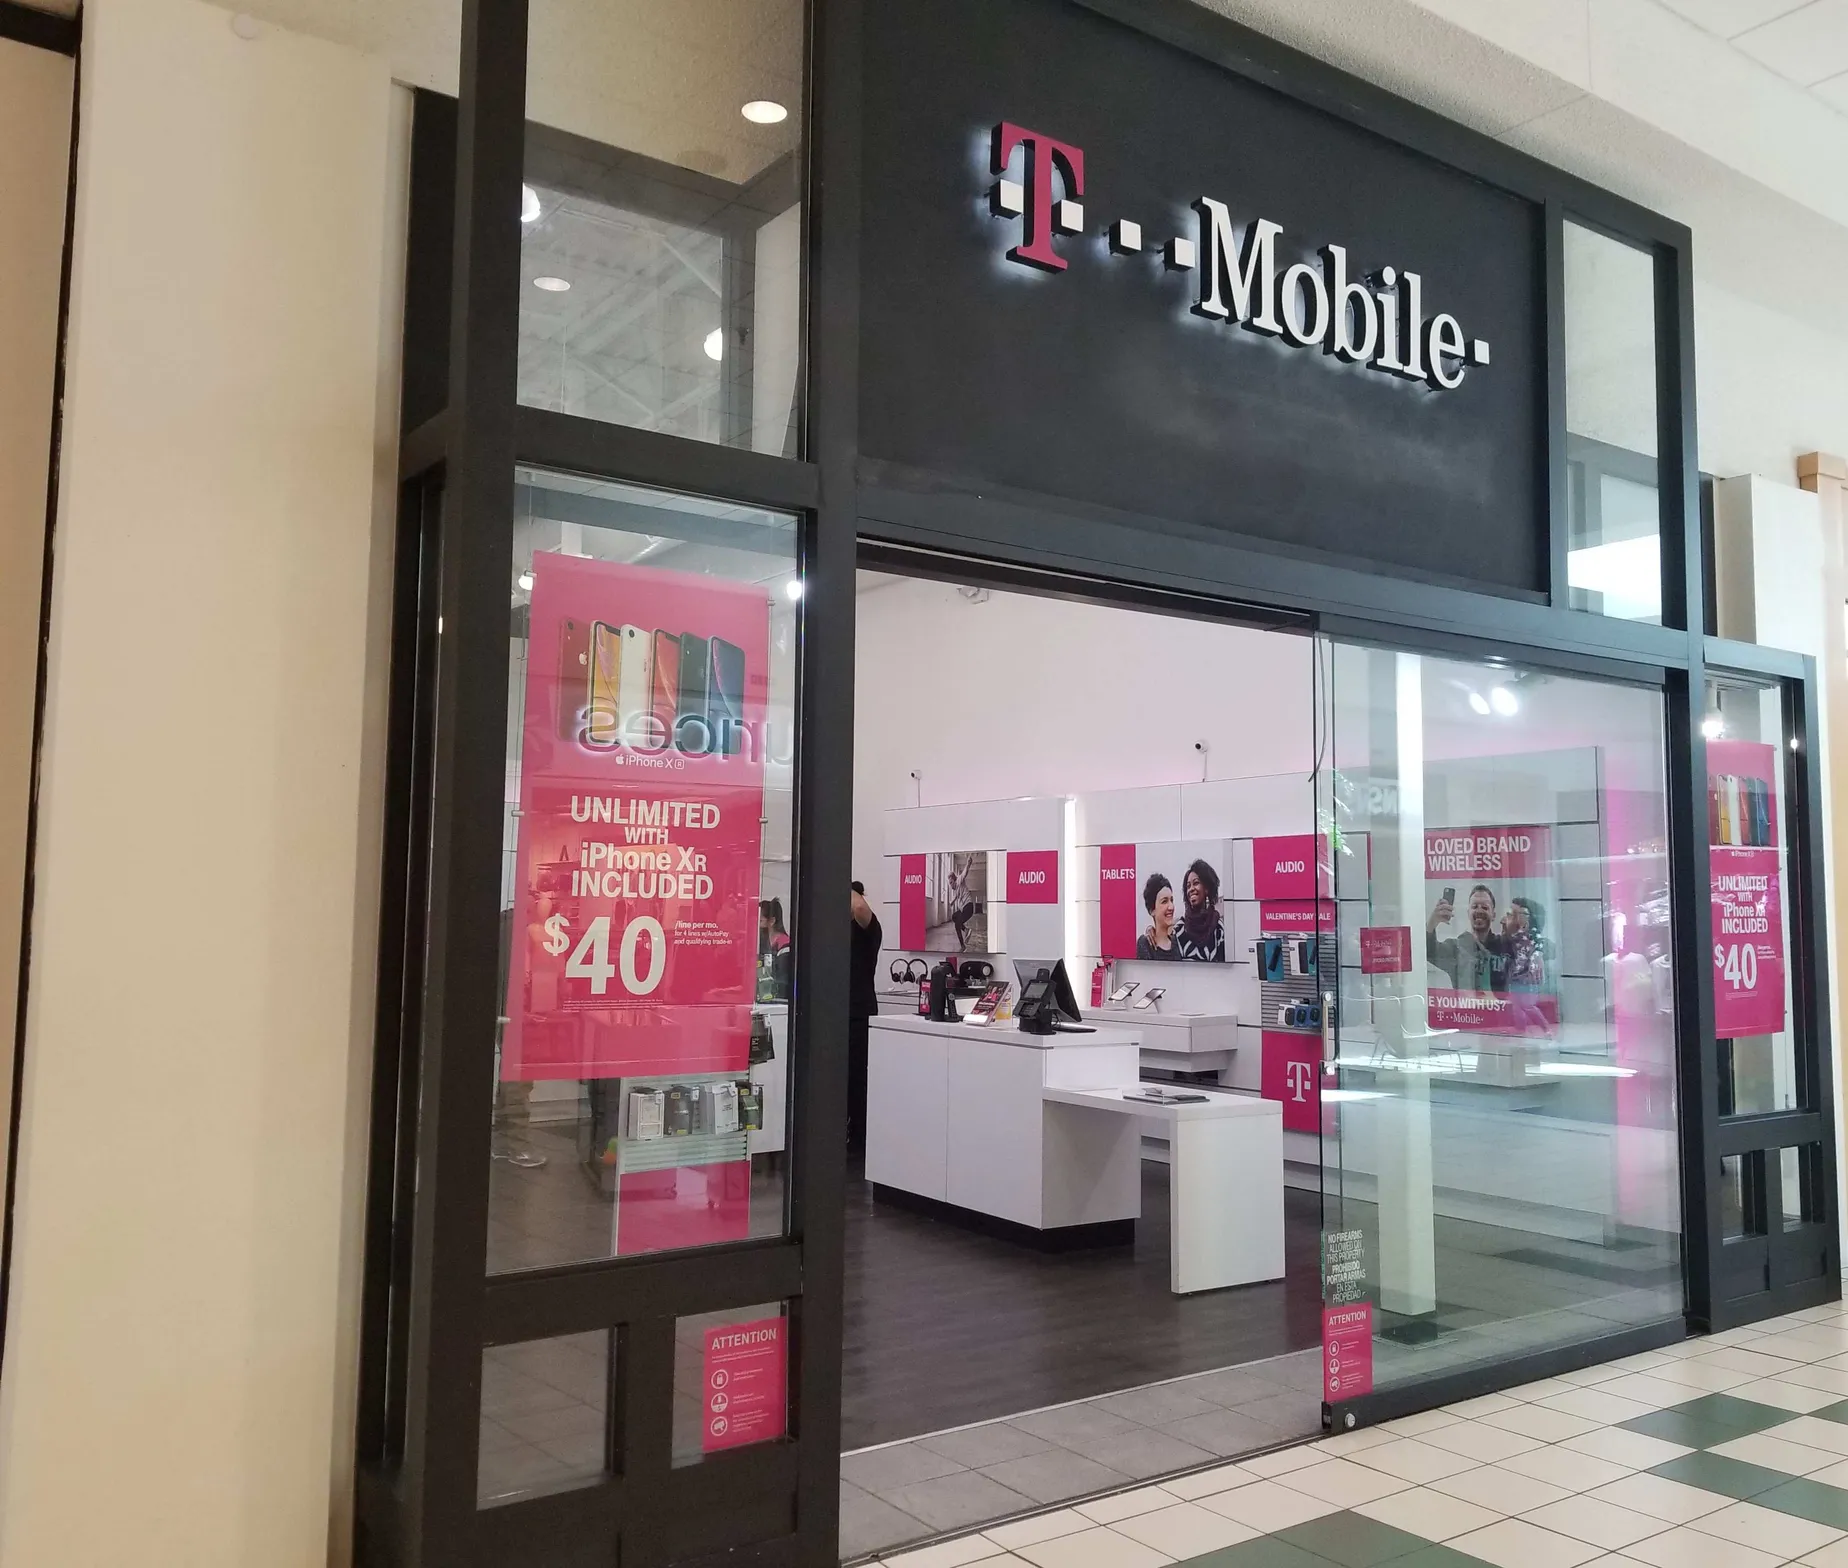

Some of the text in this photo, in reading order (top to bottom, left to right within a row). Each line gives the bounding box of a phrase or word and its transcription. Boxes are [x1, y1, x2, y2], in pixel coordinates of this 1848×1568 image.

[571, 795, 721, 830] UNLIMITED
[624, 826, 669, 845] WITH
[1427, 836, 1531, 855] LOVED BRAND
[580, 841, 672, 872] iPhone
[1428, 854, 1502, 872] WIRELESS
[1101, 868, 1135, 880] TABLETS
[1275, 861, 1305, 873] AUDIO
[571, 870, 714, 900] INCLUDED
[904, 874, 923, 884] AUDIO
[1018, 871, 1046, 885] AUDIO
[1718, 875, 1768, 892] UNLIMITED
[1738, 891, 1753, 902] WITH
[1265, 911, 1331, 920] VALENTINE'S DAY ALE
[1723, 902, 1755, 918] iPhone
[692, 922, 704, 930] per
[1722, 918, 1768, 934] INCLUDED
[542, 912, 667, 996] $40
[1714, 943, 1757, 990] $40
[1436, 997, 1457, 1009] YOU
[1458, 997, 1485, 1010] WITH
[1486, 1000, 1507, 1012] US?
[1328, 1229, 1363, 1244] NO FIREARMS
[1327, 1253, 1338, 1264] THIS
[1328, 1310, 1367, 1326] ATTENTION
[711, 1327, 777, 1351] ATTENTION
